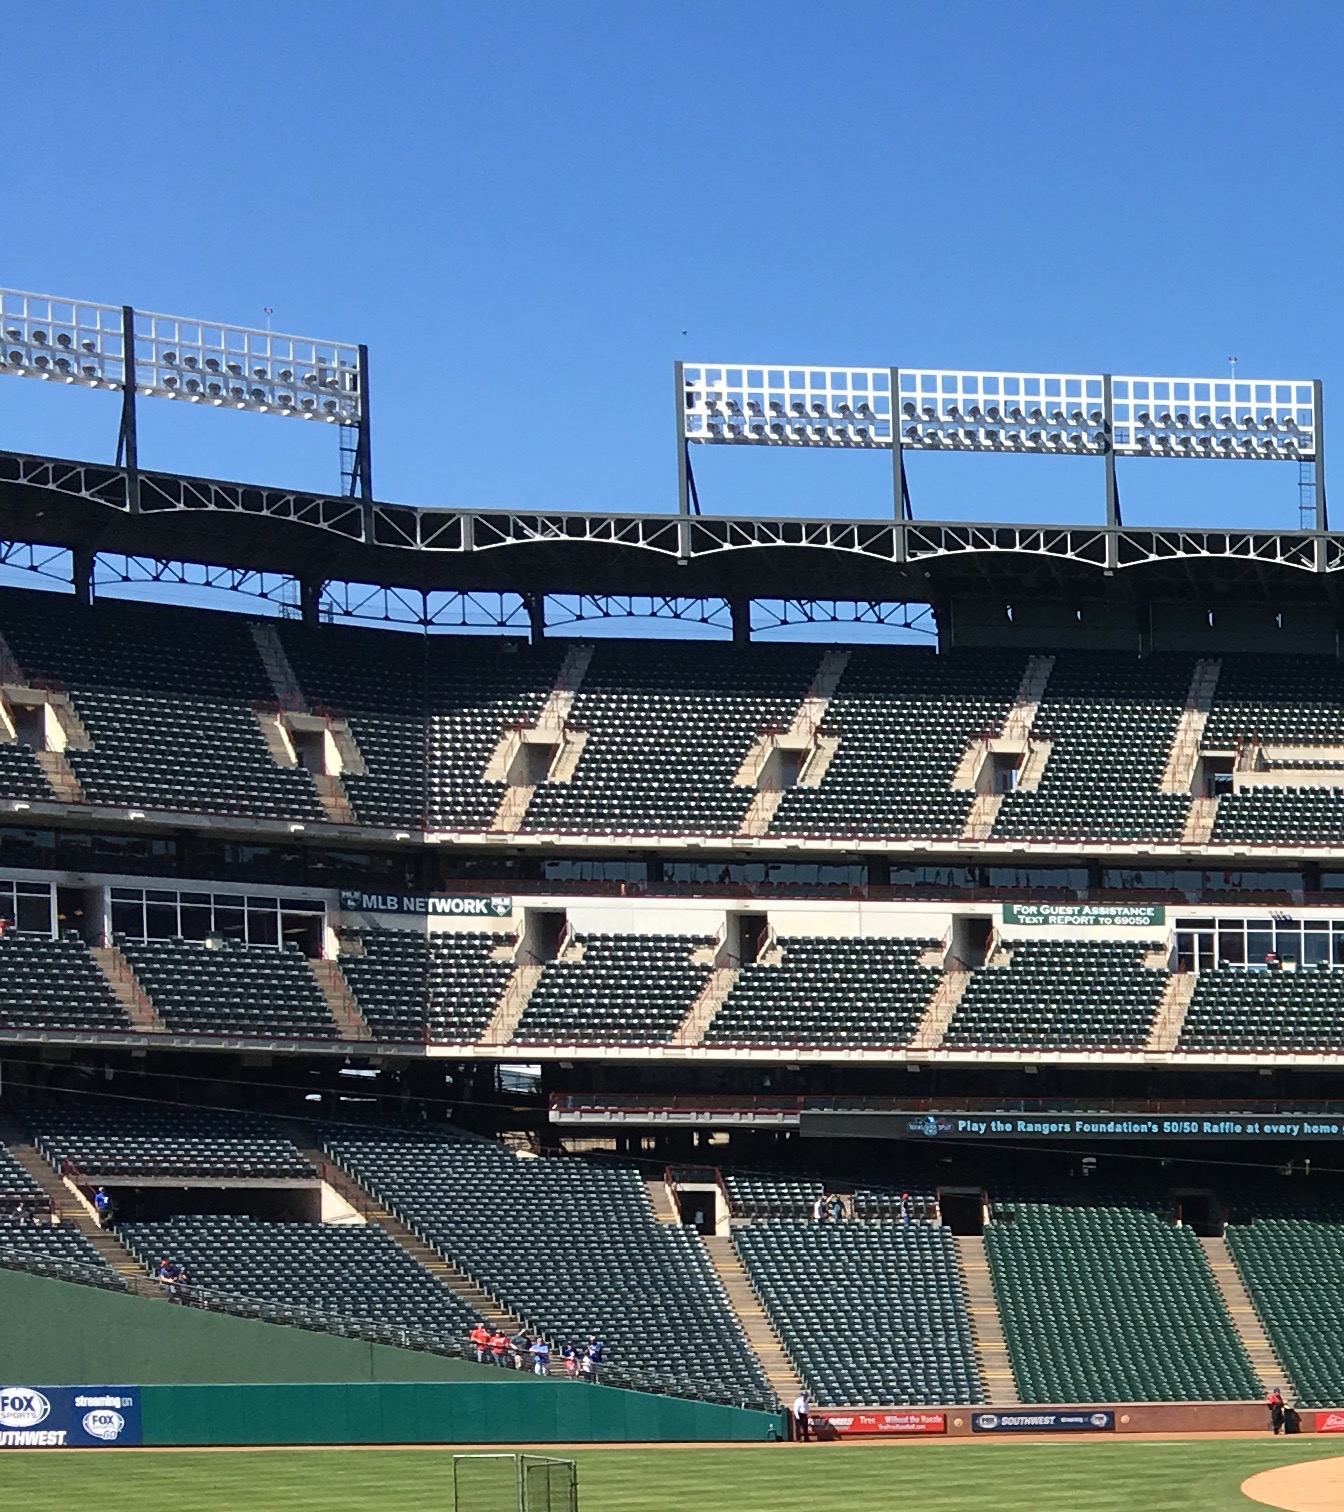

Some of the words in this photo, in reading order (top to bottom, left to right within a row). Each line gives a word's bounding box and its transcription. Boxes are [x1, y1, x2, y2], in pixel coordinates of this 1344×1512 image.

[362, 894, 398, 909] MLB
[403, 897, 488, 913] NETWORK
[1013, 905, 1037, 914] FOR
[1040, 905, 1079, 915] GUEST
[1082, 906, 1154, 916] ASSISTANCE
[1049, 916, 1095, 924] REPORT
[1114, 916, 1150, 925] 69050
[958, 1121, 986, 1134] Play
[991, 1121, 1012, 1132] the
[1018, 1121, 1070, 1134] Rangers
[1075, 1121, 1158, 1133] Foundation's
[1163, 1122, 1198, 1133] 50/50
[1203, 1122, 1242, 1133] Raffle
[1247, 1123, 1260, 1133] at
[1264, 1125, 1299, 1136] every
[1304, 1122, 1338, 1134] home
[1, 1396, 35, 1412] FOX
[74, 1395, 121, 1408] streaming
[122, 1398, 133, 1407] on
[92, 1415, 114, 1425] FOX
[1002, 1416, 1056, 1426] SOUTHWEST
